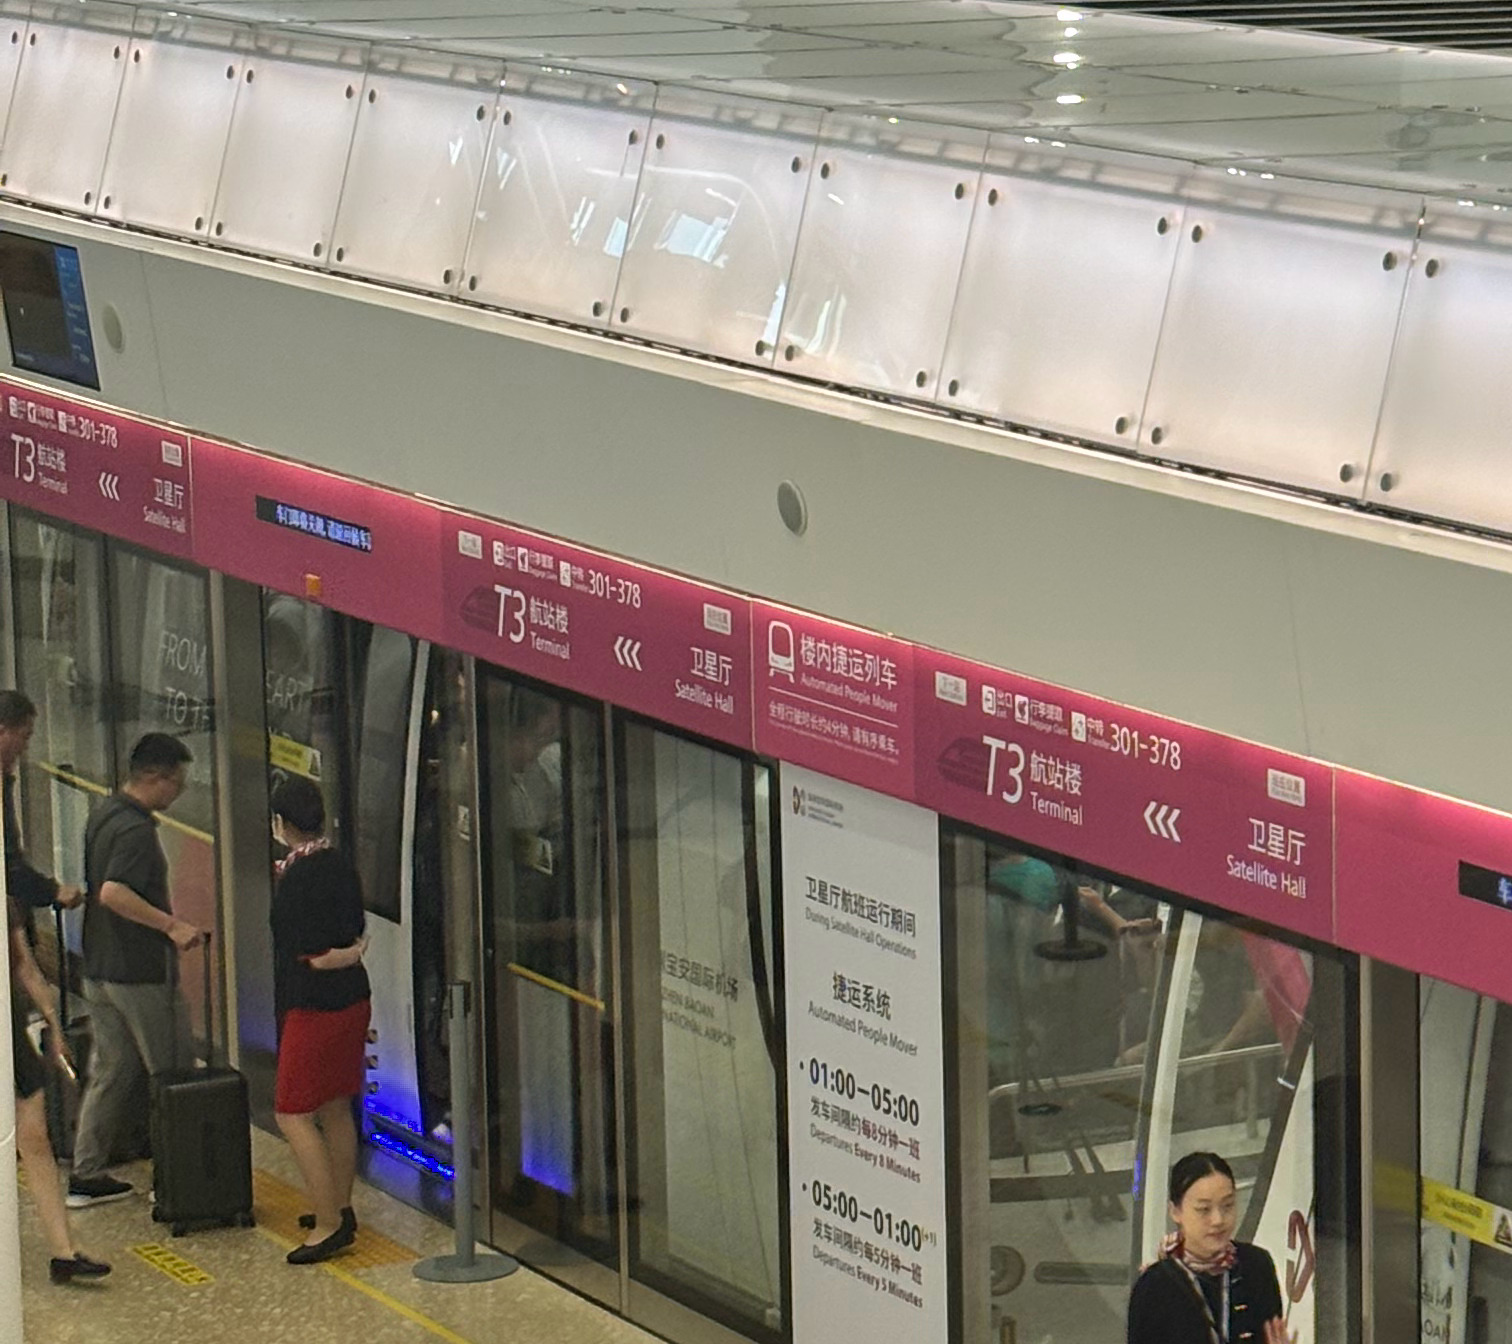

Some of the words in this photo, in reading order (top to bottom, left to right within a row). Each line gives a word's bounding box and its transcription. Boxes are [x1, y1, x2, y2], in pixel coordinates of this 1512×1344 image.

[11, 433, 35, 482] T3
[153, 478, 184, 509] 卫星厅
[588, 569, 641, 608] 301-378
[494, 584, 526, 643] T3
[530, 595, 568, 634] 航站楼
[530, 631, 570, 660] Terminal
[690, 647, 732, 686] 卫星厅
[800, 633, 898, 690] 楼内捷运列车
[675, 679, 713, 707] Satellite
[714, 691, 734, 714] Hall
[982, 735, 1025, 804] T3
[1110, 723, 1181, 770] 301-378
[1030, 749, 1082, 796] 航站楼
[1030, 792, 1083, 826] Terminal
[1248, 817, 1306, 865] 卫星厅
[1227, 854, 1277, 890] Satellite
[1280, 872, 1306, 899] Hall
[805, 876, 916, 938] 卫星厅航班运行期间
[832, 971, 892, 1021] 捷运系统
[808, 1000, 857, 1034] Automated
[858, 1019, 888, 1046] People
[889, 1032, 918, 1056] Mover
